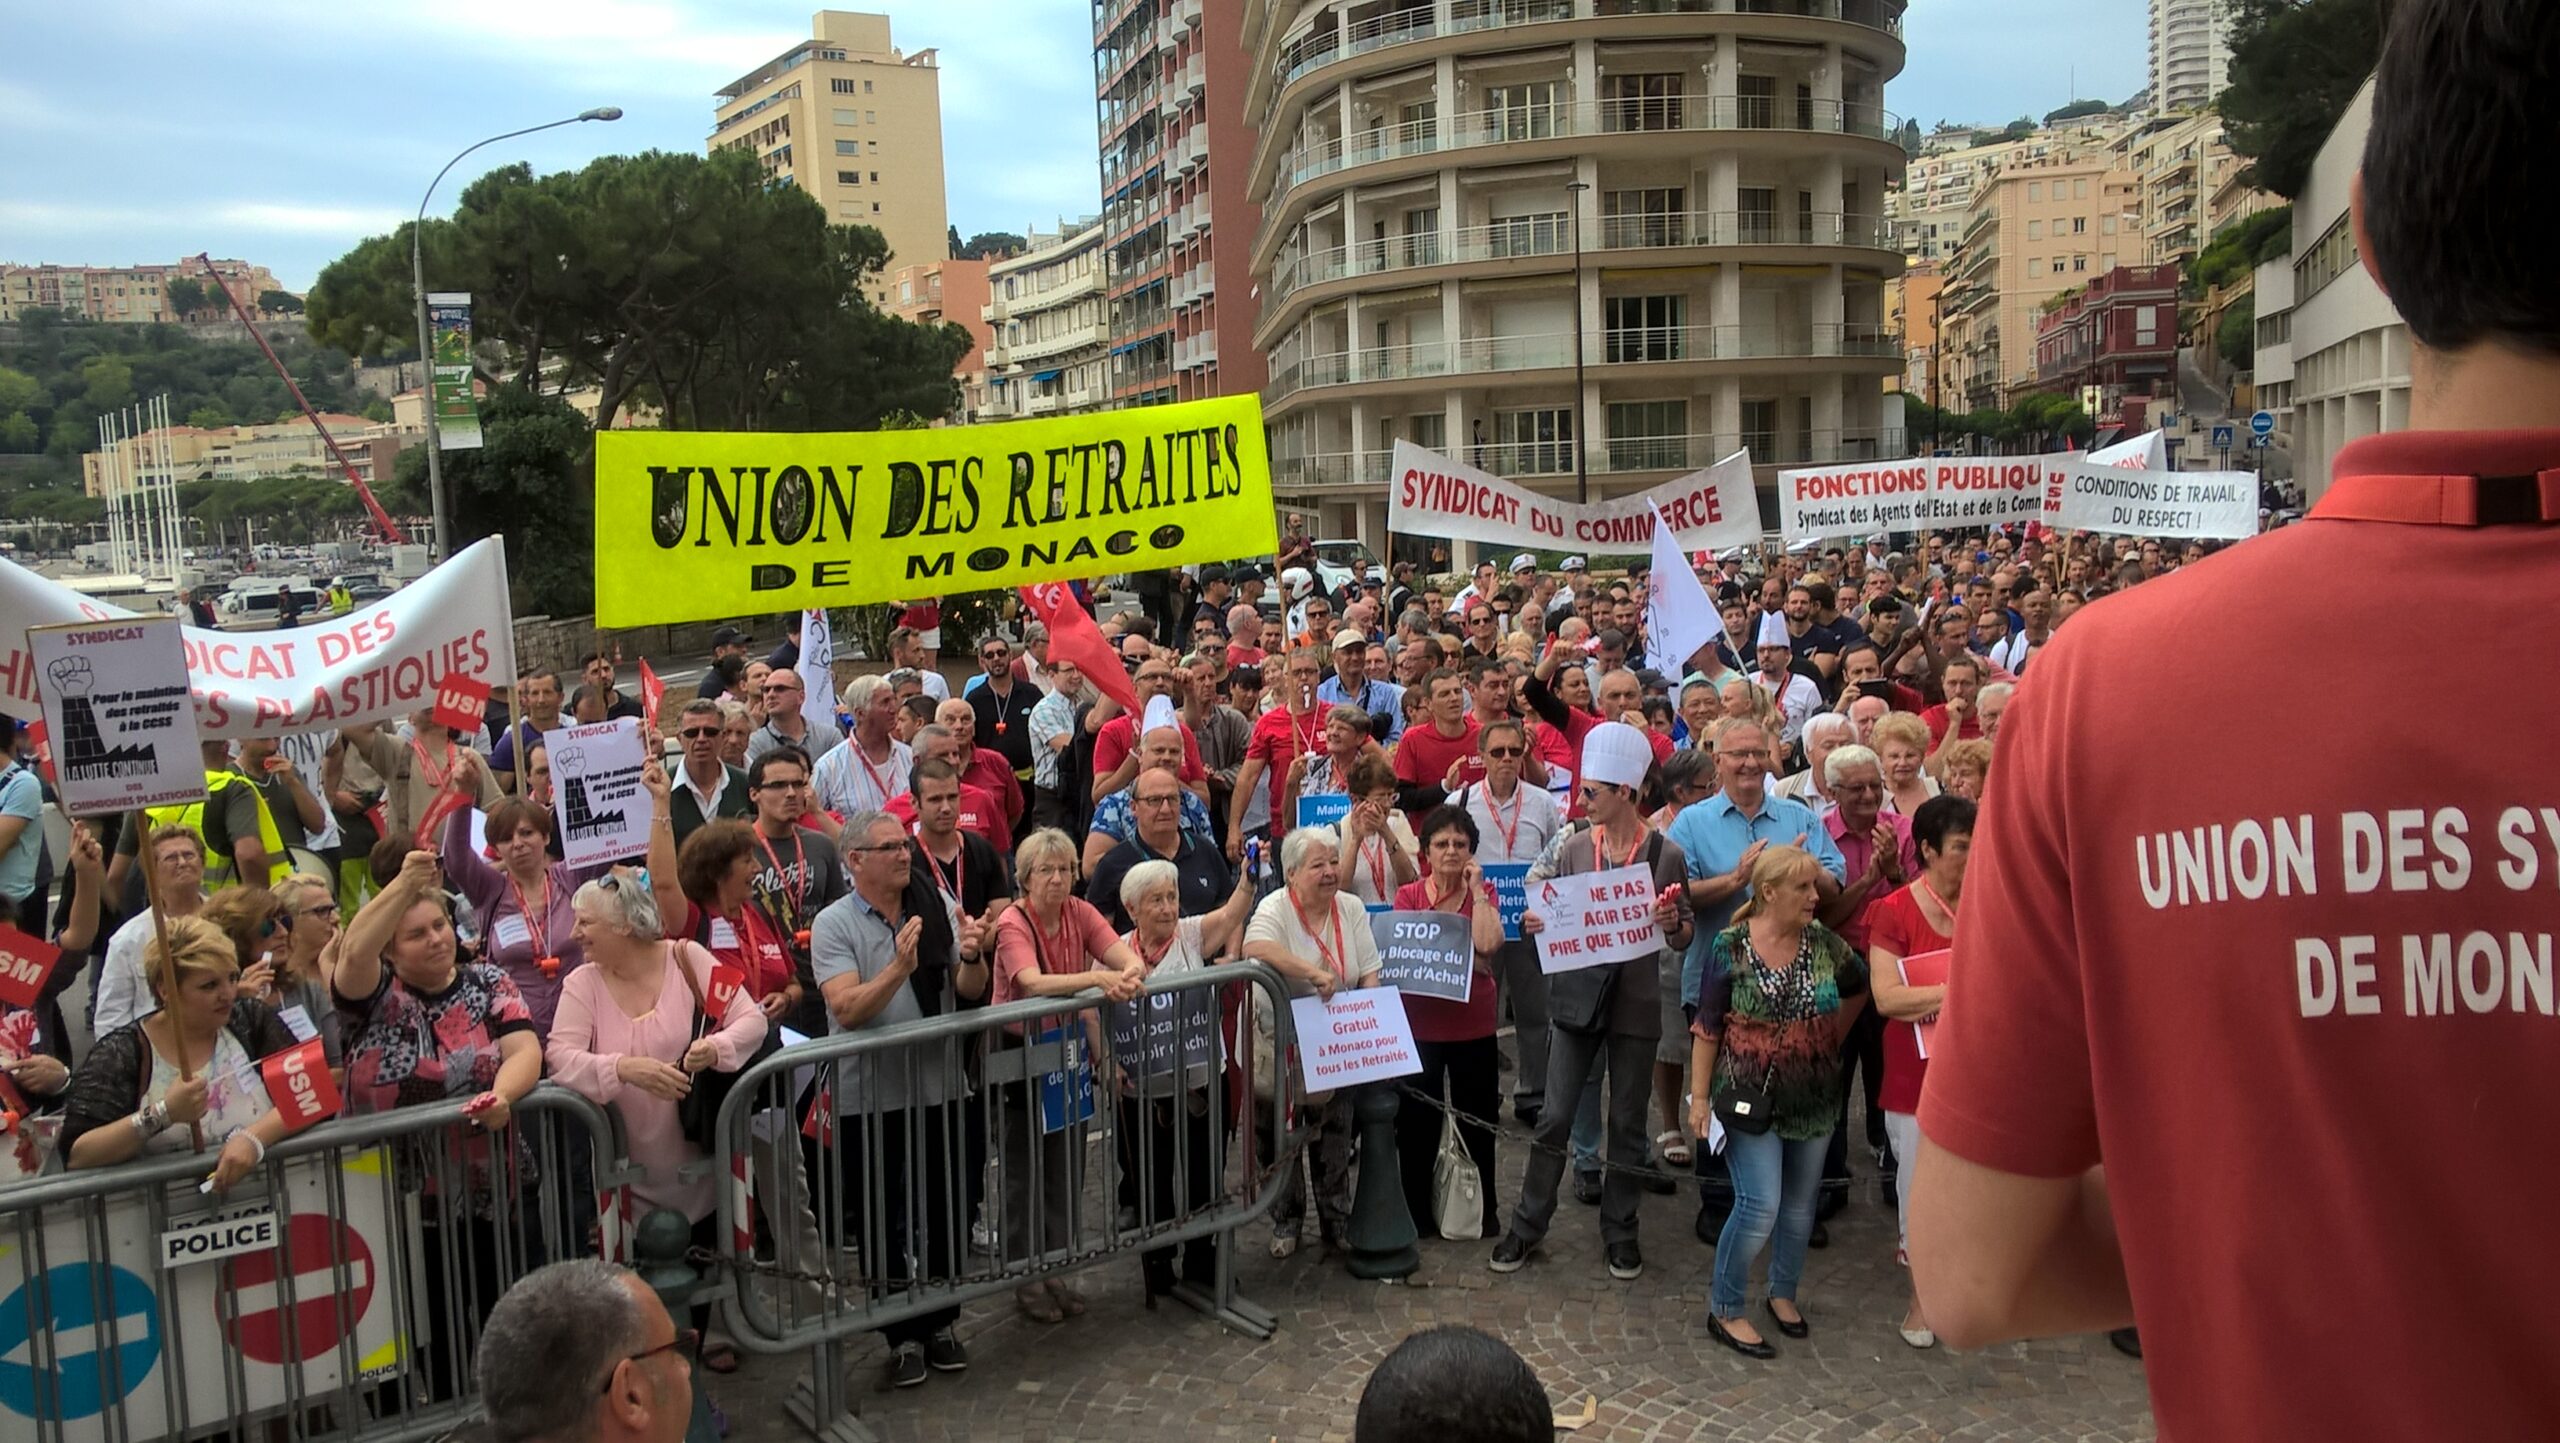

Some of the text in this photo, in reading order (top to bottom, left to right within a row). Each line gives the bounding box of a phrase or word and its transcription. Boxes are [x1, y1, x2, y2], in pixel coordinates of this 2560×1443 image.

[647, 423, 1241, 549] UNION DES RETRAITES
[1796, 463, 2042, 501] FONCTIONS PUBLIQU
[2075, 475, 2158, 501] CONDITIONS
[2164, 485, 2182, 502] DE
[2188, 485, 2237, 503] TRAVAIL
[1402, 468, 1723, 543] SYNDICAT DU COMMERCE
[1798, 507, 1846, 536] Syndicat
[1850, 505, 1868, 524] des
[1873, 503, 1911, 528] Agents
[1963, 500, 1975, 516] et
[1979, 497, 1993, 515] de
[1996, 496, 2007, 513] la
[2112, 507, 2132, 525] DU
[2138, 509, 2193, 529] RESPECT
[750, 523, 1186, 592] DE MONACO
[67, 627, 144, 646] SYNDICAT
[317, 610, 398, 669] DES
[254, 629, 490, 729] PLASTIQUES
[92, 693, 120, 705] Pour
[106, 707, 127, 719] des
[142, 716, 173, 730] CCSS
[568, 723, 619, 740] SYNDICAT
[70, 787, 205, 812] CHIMIQUES PLASTIQUES
[125, 783, 143, 792] DES
[2136, 814, 2318, 909] UNION
[2341, 807, 2473, 894] DES
[1590, 880, 1646, 903] NE PAS
[1584, 909, 1620, 928] AGIR
[1622, 903, 1650, 922] EST
[1394, 922, 1441, 940] STOP
[1548, 923, 1655, 958] PIRE QUE TOUT
[1379, 945, 1463, 965] u Blocage du
[1377, 965, 1466, 987] uvoir d'Achat
[2295, 931, 2560, 1018] DE MON
[1325, 999, 1375, 1015] Transport
[1332, 1016, 1379, 1035] Gratuit
[1318, 1035, 1398, 1057] à Monaco pour
[1316, 1050, 1409, 1076] tous les Retraités
[283, 1050, 322, 1117] USM
[169, 1222, 271, 1259] POLICE
